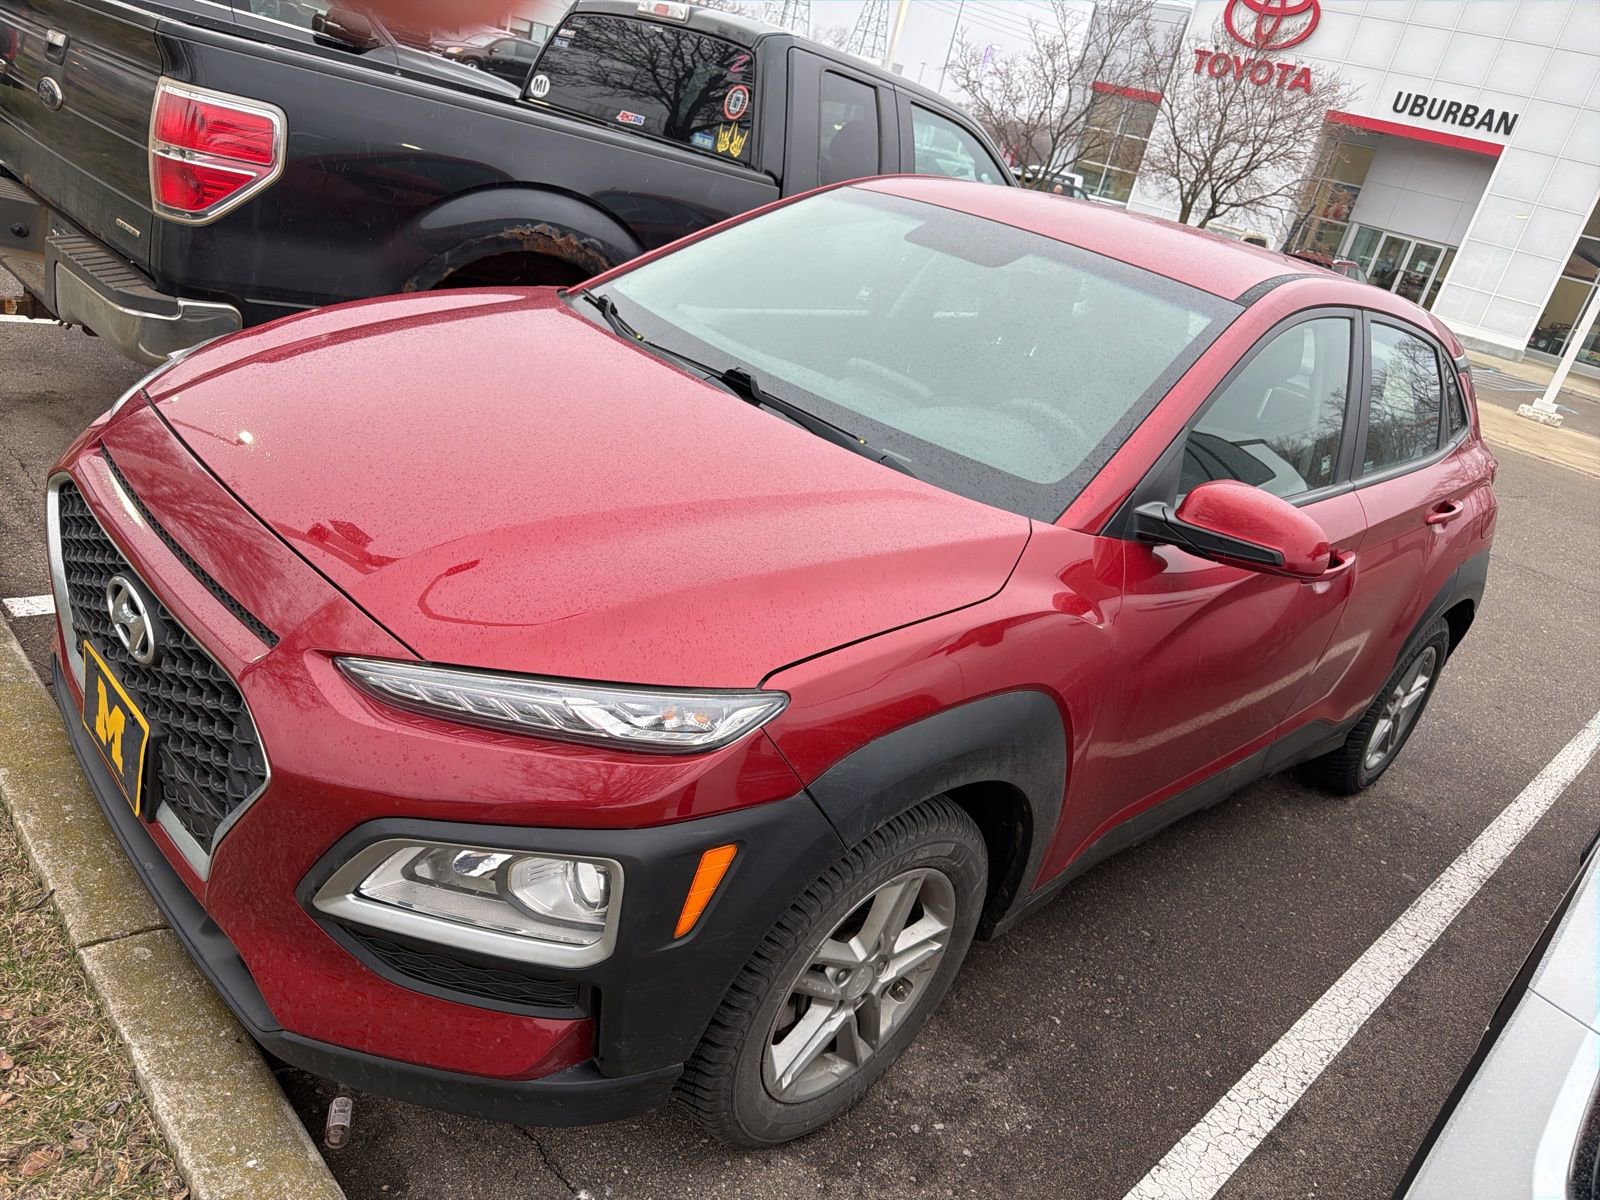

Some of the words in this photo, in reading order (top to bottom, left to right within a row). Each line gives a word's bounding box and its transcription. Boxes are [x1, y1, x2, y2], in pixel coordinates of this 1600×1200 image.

[533, 78, 548, 93] MI
[1194, 49, 1312, 95] TOYOTA
[1392, 91, 1519, 136] UBURBAN
[95, 675, 126, 777] M
